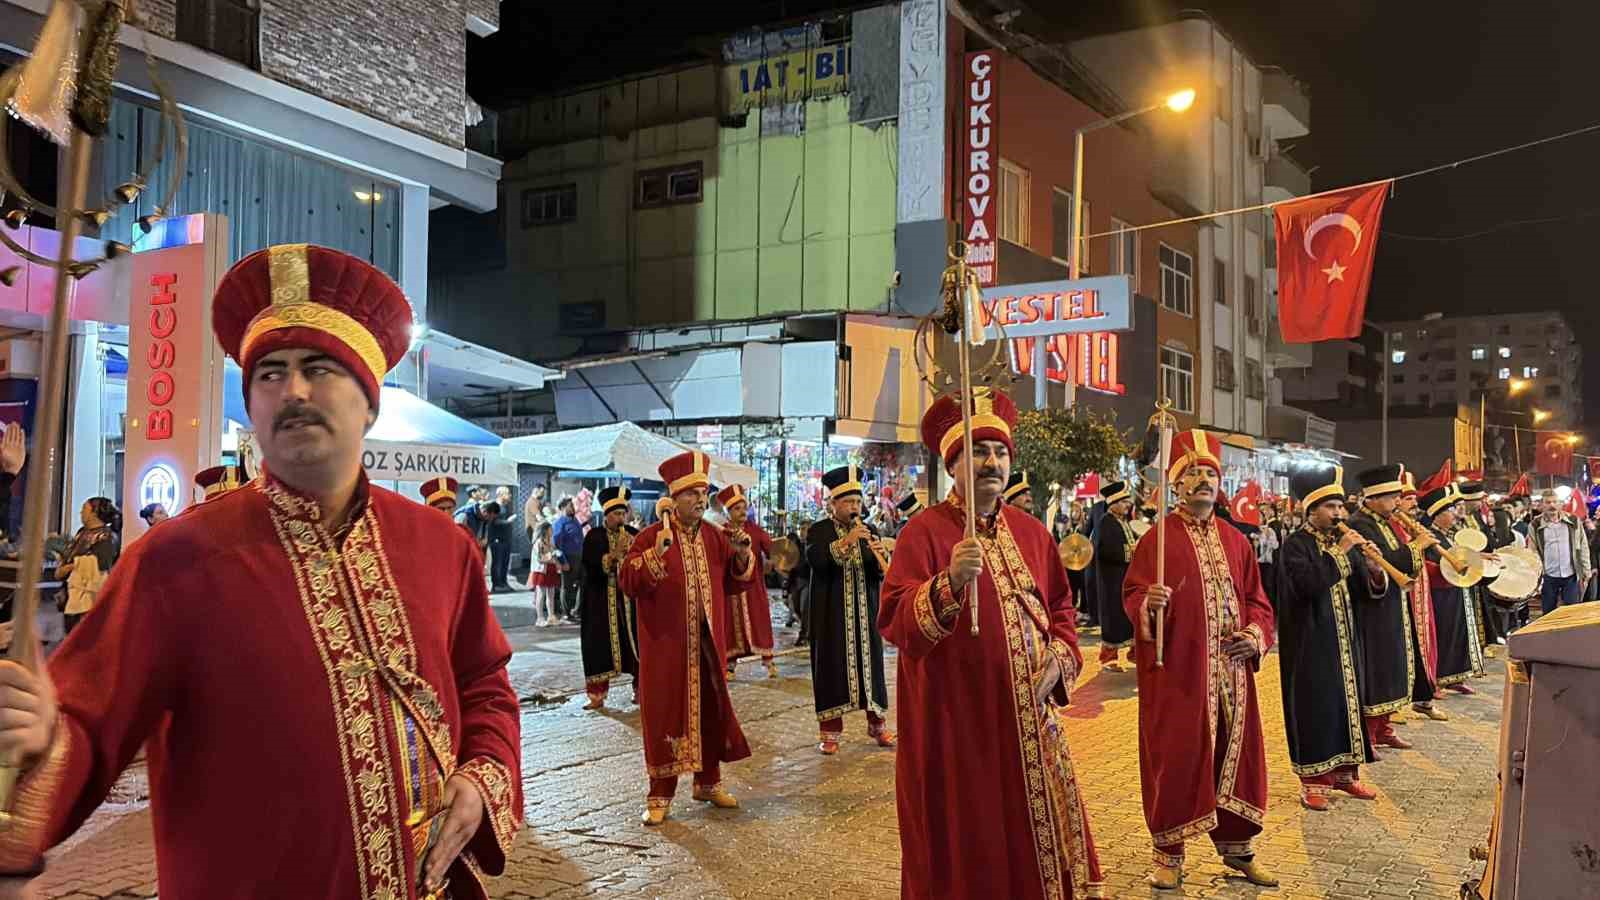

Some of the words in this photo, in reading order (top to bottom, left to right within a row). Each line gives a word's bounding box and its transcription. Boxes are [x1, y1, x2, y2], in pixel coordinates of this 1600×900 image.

[968, 54, 991, 240] ÇUKUROVA
[147, 272, 177, 440] BOSCH
[980, 289, 1104, 327] VESTEL
[394, 450, 486, 477] ŞARKÜTERİ
